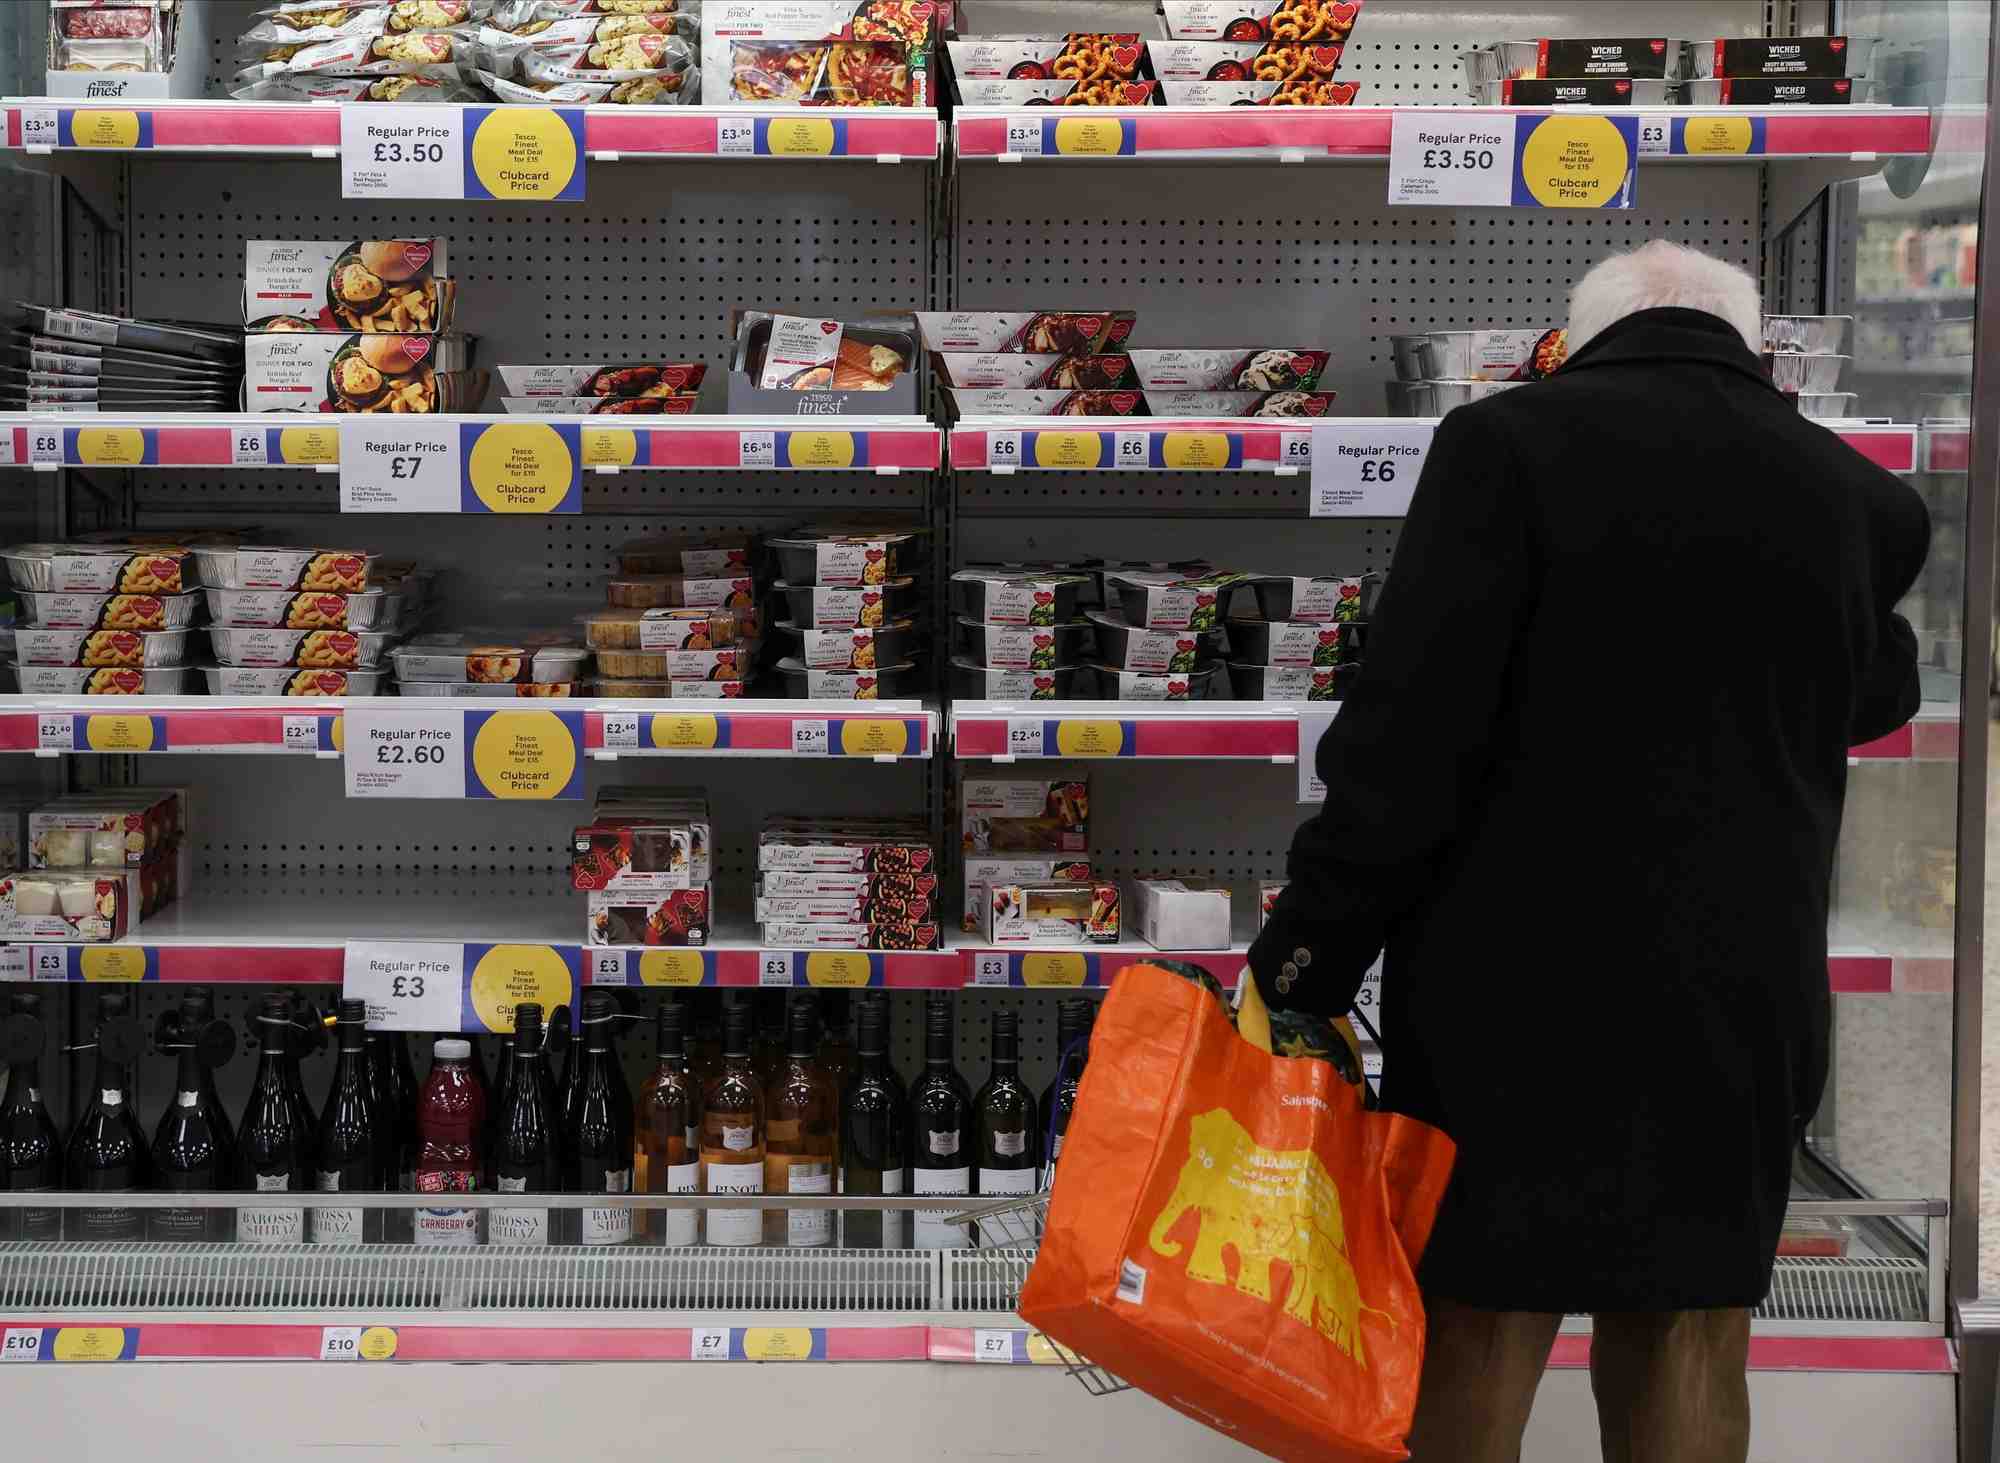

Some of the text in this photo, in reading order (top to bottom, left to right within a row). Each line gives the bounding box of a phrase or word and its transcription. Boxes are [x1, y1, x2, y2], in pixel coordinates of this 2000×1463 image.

[1591, 46, 1622, 55] WICKED
[1768, 45, 1801, 54] WICKED
[86, 83, 123, 99] finest
[1555, 87, 1587, 96] WICKED
[1774, 86, 1806, 96] WICKED
[25, 120, 55, 131] £3.50
[367, 126, 450, 138] Regular Price
[721, 128, 751, 140] £3.50
[1010, 127, 1040, 141] £3.50
[1418, 133, 1502, 146] Regular Price
[1642, 127, 1663, 141] £3
[1567, 140, 1588, 148] Tesco
[374, 143, 443, 163] £3.50
[1423, 149, 1494, 170] £3.50
[500, 171, 549, 181] Clubcard
[511, 181, 539, 191] Price
[1548, 178, 1599, 189] Clubcard
[1559, 188, 1588, 199] Price
[269, 250, 300, 264] finest
[268, 344, 299, 358] finest
[795, 396, 843, 415] finest
[36, 437, 57, 451] £8
[239, 438, 260, 451] £6
[365, 441, 447, 455] Regular Price
[743, 443, 772, 453] £6.50
[994, 441, 1015, 454] £6
[1122, 442, 1142, 455] £6
[1288, 442, 1309, 456] £6
[1338, 445, 1420, 458] Regular Price
[391, 456, 422, 479] £7
[1361, 460, 1395, 482] £6
[497, 485, 546, 495] Clubcard
[507, 495, 536, 504] Price
[41, 725, 71, 736] £2.60
[286, 726, 316, 738] £2.60
[607, 723, 636, 734] £2.60
[370, 729, 452, 742] Regular Price
[797, 730, 826, 741] £2.60
[1011, 730, 1041, 742] £2.60
[377, 745, 445, 764] £2.60
[500, 771, 550, 781] Clubcard
[511, 781, 539, 790] Price
[40, 956, 60, 969] £3
[369, 960, 451, 973] Regular Price
[600, 959, 619, 973] £3
[767, 961, 786, 974] £3
[983, 962, 1002, 975] £3
[392, 976, 424, 998] £3
[677, 1183, 698, 1193] PIN
[715, 1183, 759, 1193] PINOT
[242, 1212, 299, 1225] BAROSSA
[592, 1208, 631, 1221] BAROS
[246, 1224, 297, 1236] SHIRAZ
[420, 1218, 465, 1230] CRANBERRY
[6, 1336, 38, 1350] £10
[327, 1338, 355, 1351] £10
[701, 1335, 722, 1348] £7
[984, 1338, 1004, 1352] £7
